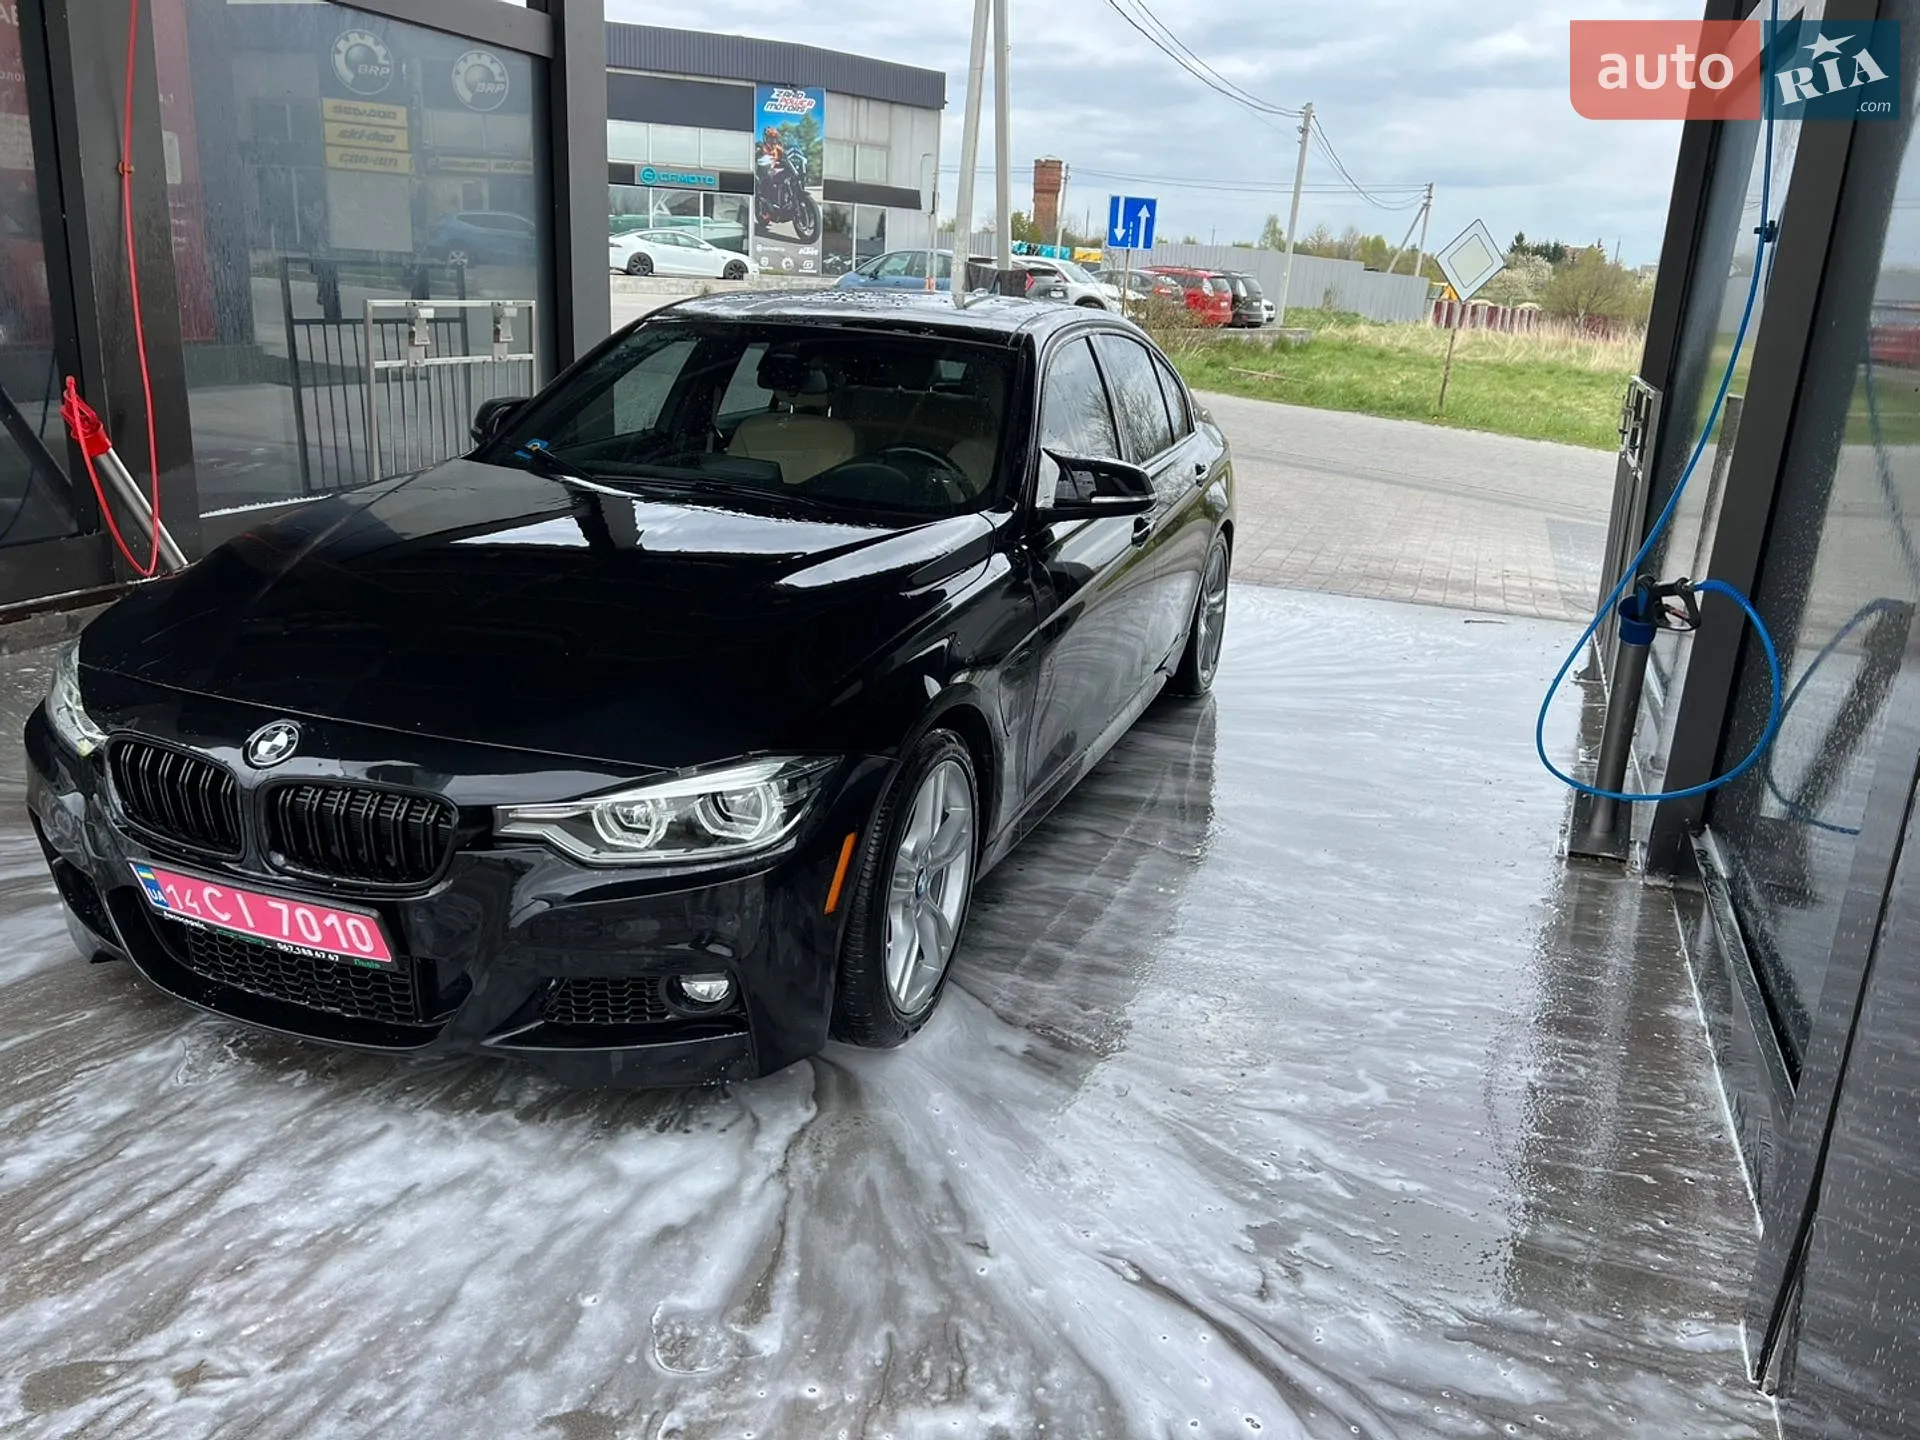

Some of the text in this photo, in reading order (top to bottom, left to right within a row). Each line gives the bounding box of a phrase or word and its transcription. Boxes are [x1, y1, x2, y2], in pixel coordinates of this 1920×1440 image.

[357, 64, 390, 77] BRP
[475, 82, 506, 95] BRP
[659, 172, 716, 186] CFMOTO
[147, 887, 167, 903] UA
[267, 899, 375, 954] 7010
